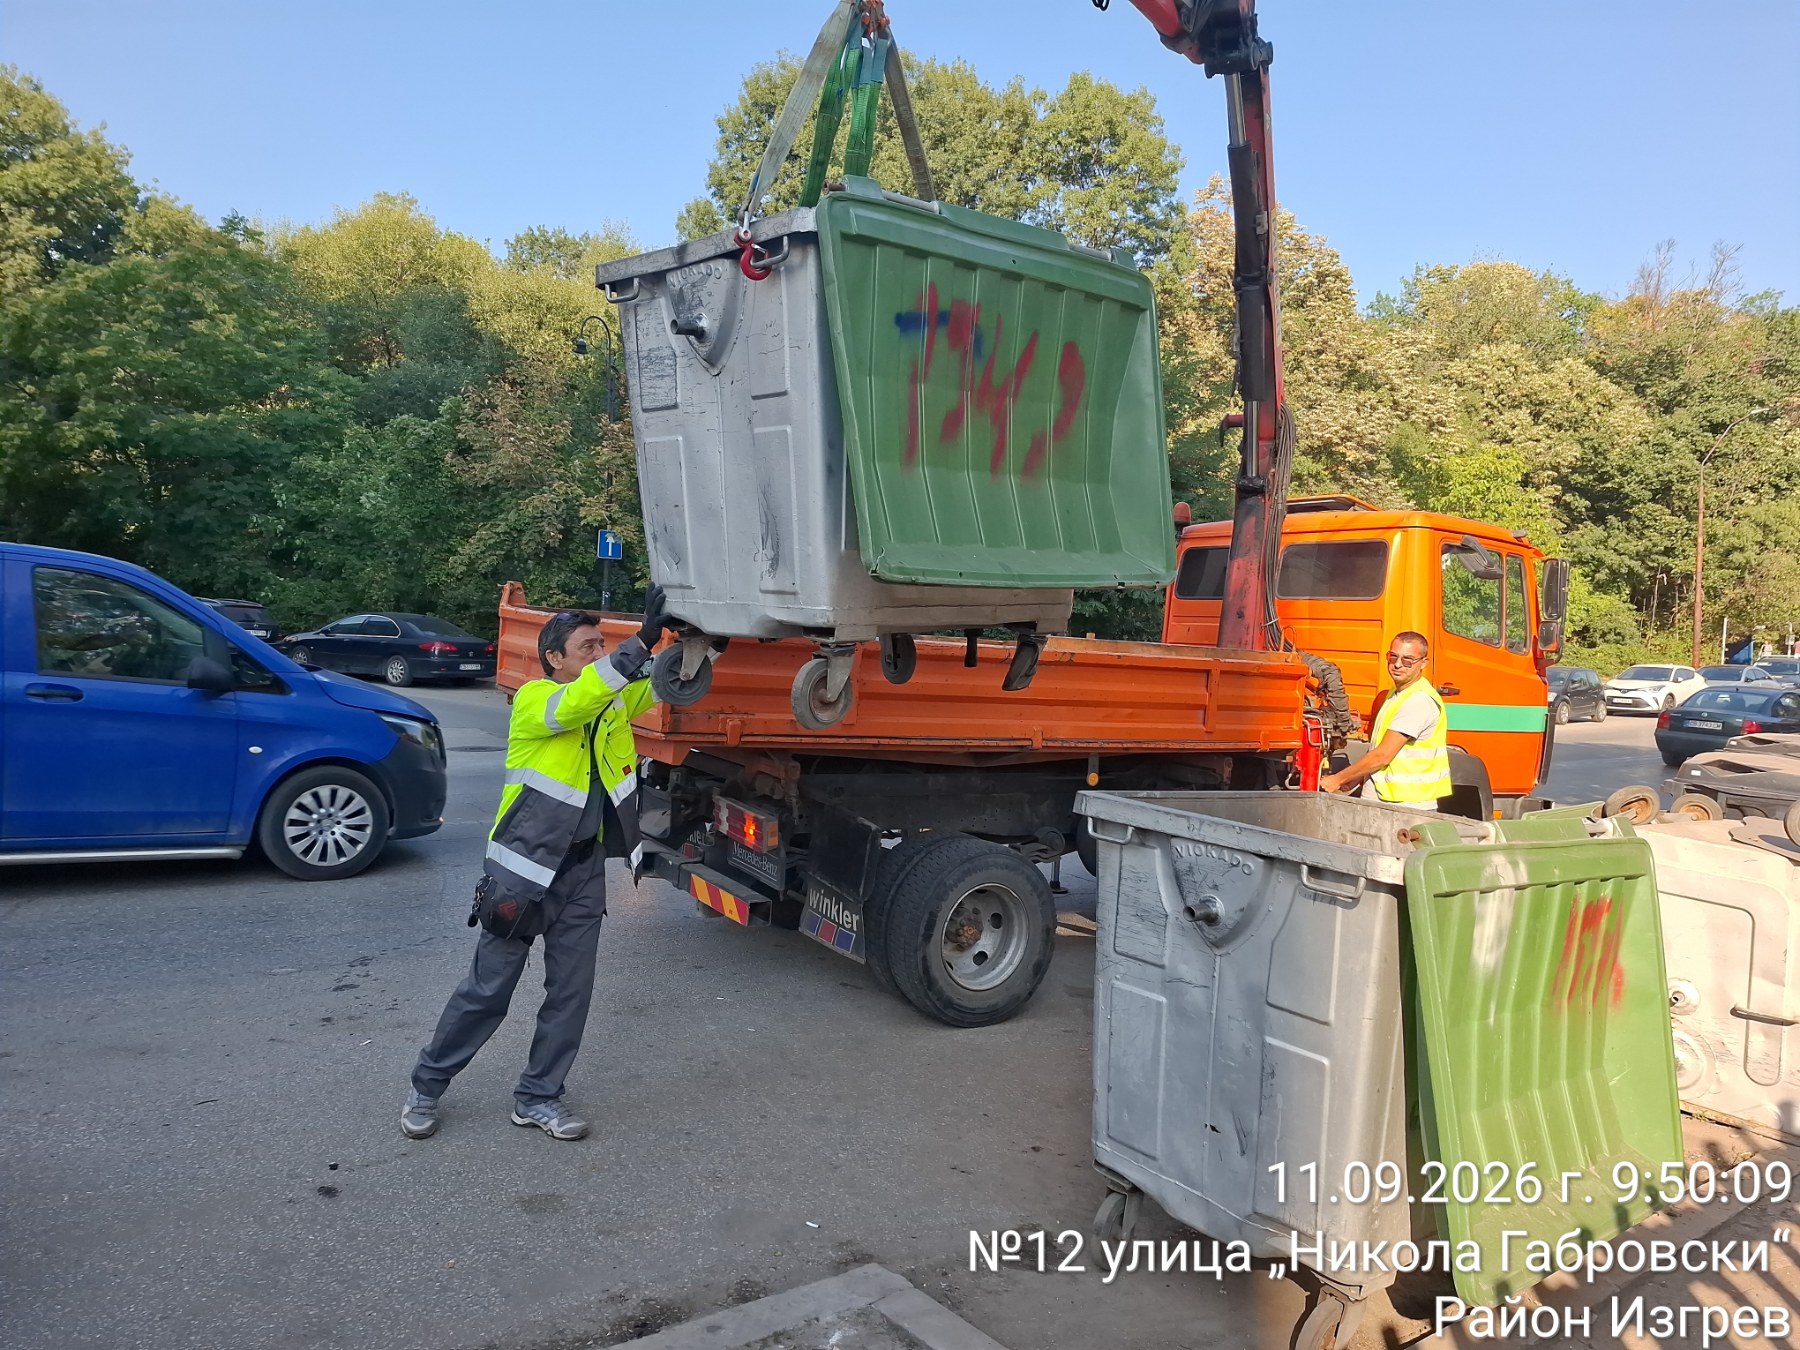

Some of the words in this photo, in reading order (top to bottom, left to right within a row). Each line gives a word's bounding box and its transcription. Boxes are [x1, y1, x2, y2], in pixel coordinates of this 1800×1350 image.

[732, 841, 779, 877] Mercedes-Benz
[1174, 844, 1255, 876] VIOKADO
[808, 887, 860, 931] winkler
